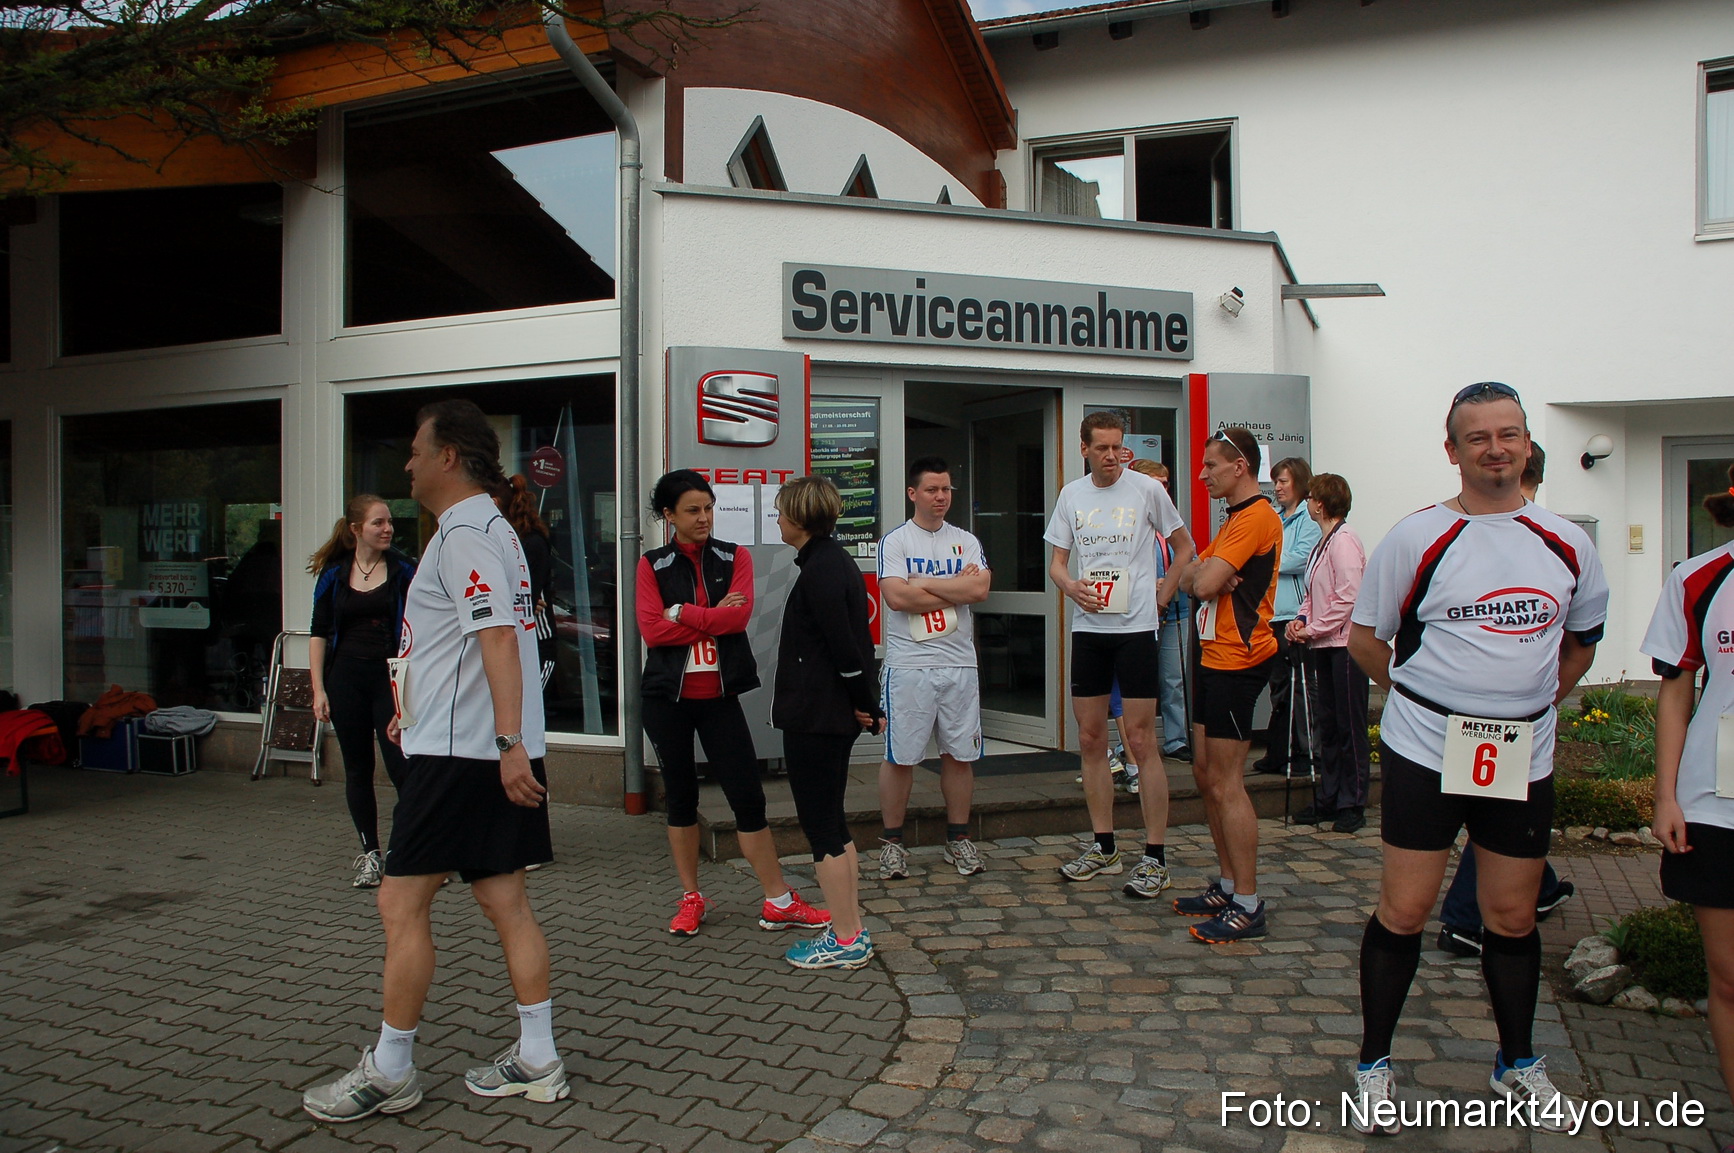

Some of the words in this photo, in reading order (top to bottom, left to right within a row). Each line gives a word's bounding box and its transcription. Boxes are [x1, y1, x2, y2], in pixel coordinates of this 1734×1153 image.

[791, 269, 1189, 353] Serviceannahme
[811, 411, 871, 419] adtmeisterschaft
[1266, 433, 1274, 441] &
[1279, 433, 1304, 444] Jänig
[143, 503, 200, 527] MEHR
[143, 529, 201, 553] WERT
[905, 557, 962, 576] ITALIA
[1094, 582, 1114, 607] 17
[921, 608, 946, 634] 19
[1446, 599, 1540, 620] GERHART
[1542, 602, 1549, 610] &
[692, 637, 717, 666] 16
[1461, 720, 1502, 733] MEYER
[1461, 730, 1502, 741] WERBUNG
[1472, 742, 1498, 787] 6
